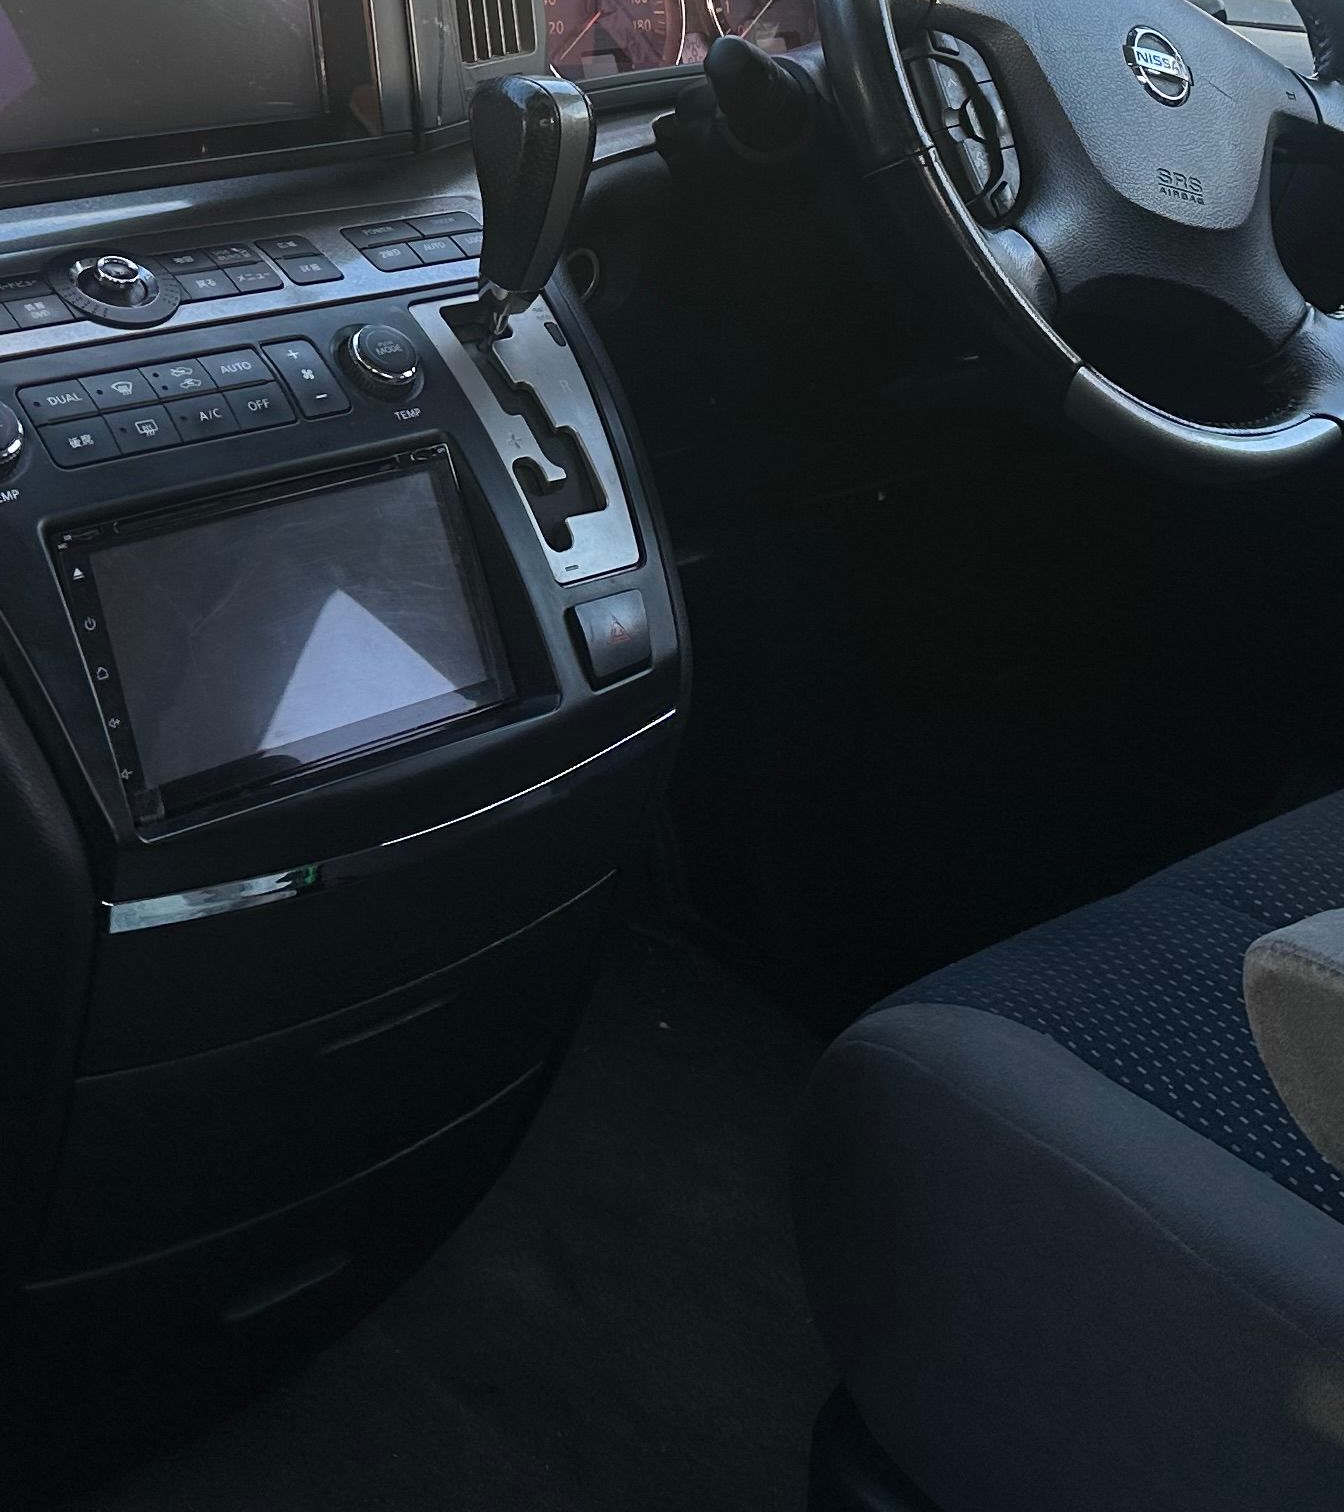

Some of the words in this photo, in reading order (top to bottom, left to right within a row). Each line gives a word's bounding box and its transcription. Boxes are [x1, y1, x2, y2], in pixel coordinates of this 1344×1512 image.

[549, 20, 564, 35] 20
[633, 18, 652, 31] 180
[1136, 50, 1184, 76] NISSA
[1157, 168, 1203, 192] SRS
[1159, 187, 1205, 205] AIRBAG
[423, 241, 446, 251] AUTO
[220, 361, 252, 374] AUTO
[46, 391, 82, 407] DUAL
[247, 398, 270, 412] OFF
[198, 408, 223, 422] A/C
[394, 407, 421, 420] TEMP
